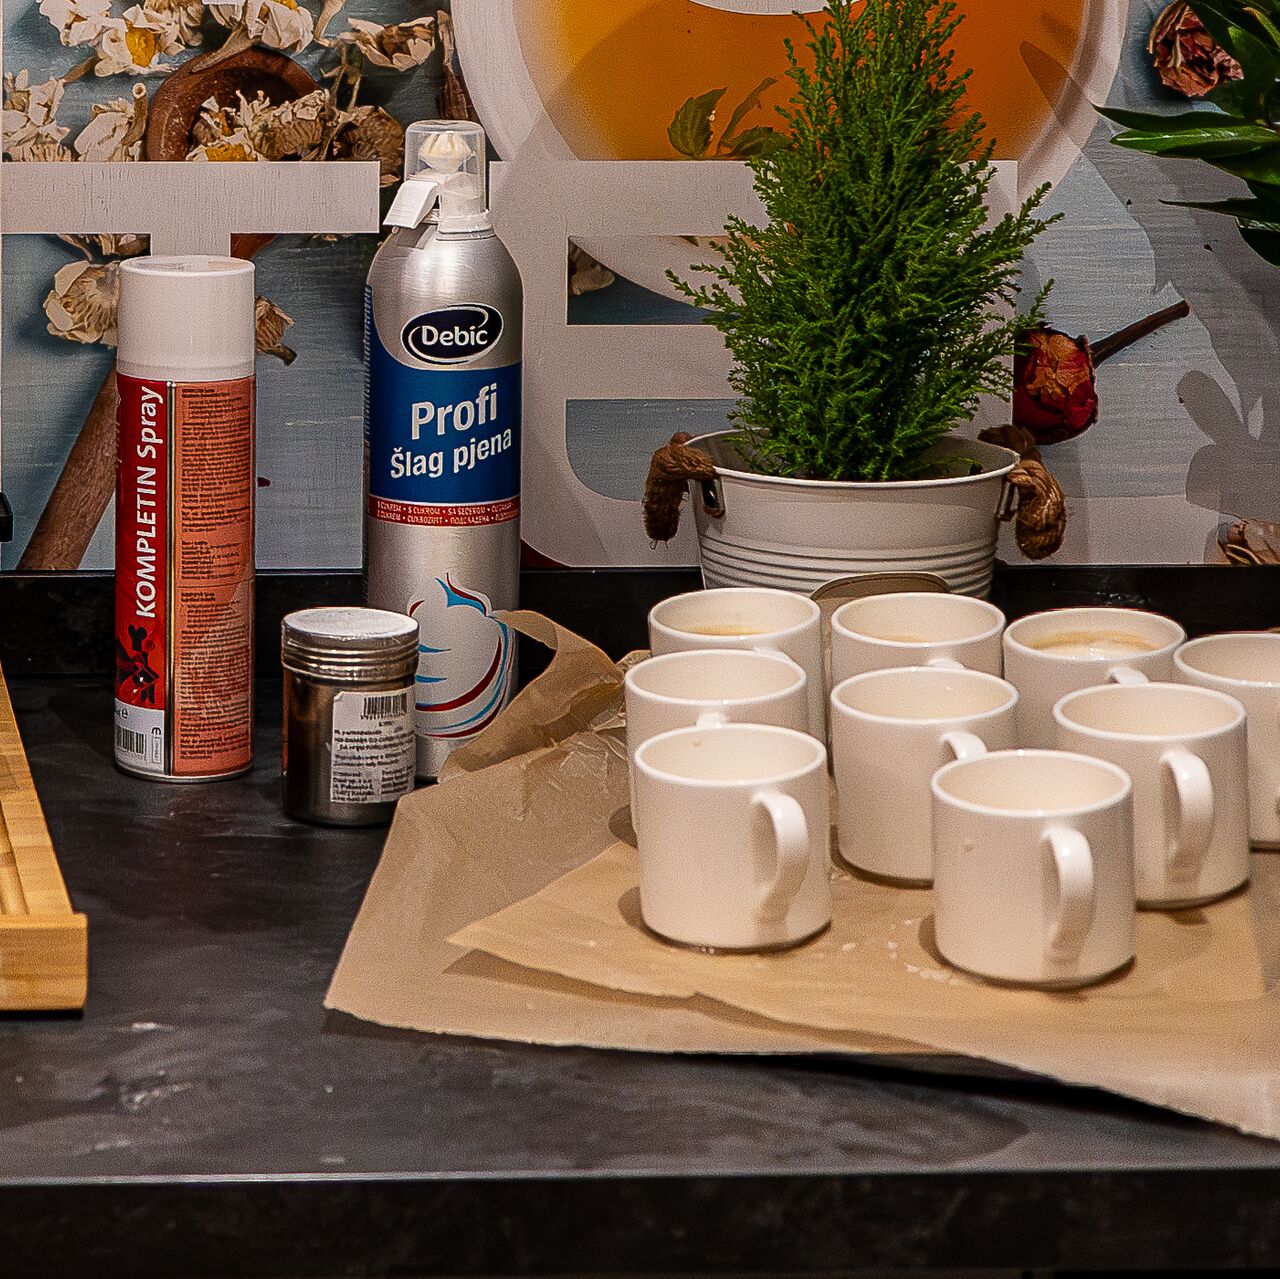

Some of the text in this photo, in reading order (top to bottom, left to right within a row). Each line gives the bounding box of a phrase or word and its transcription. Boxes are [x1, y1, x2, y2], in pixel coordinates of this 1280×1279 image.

[421, 323, 489, 348] Debic
[411, 382, 497, 440] Profi
[390, 429, 512, 479] Šlag pjena
[136, 385, 164, 618] KOMPLETIN Spray
